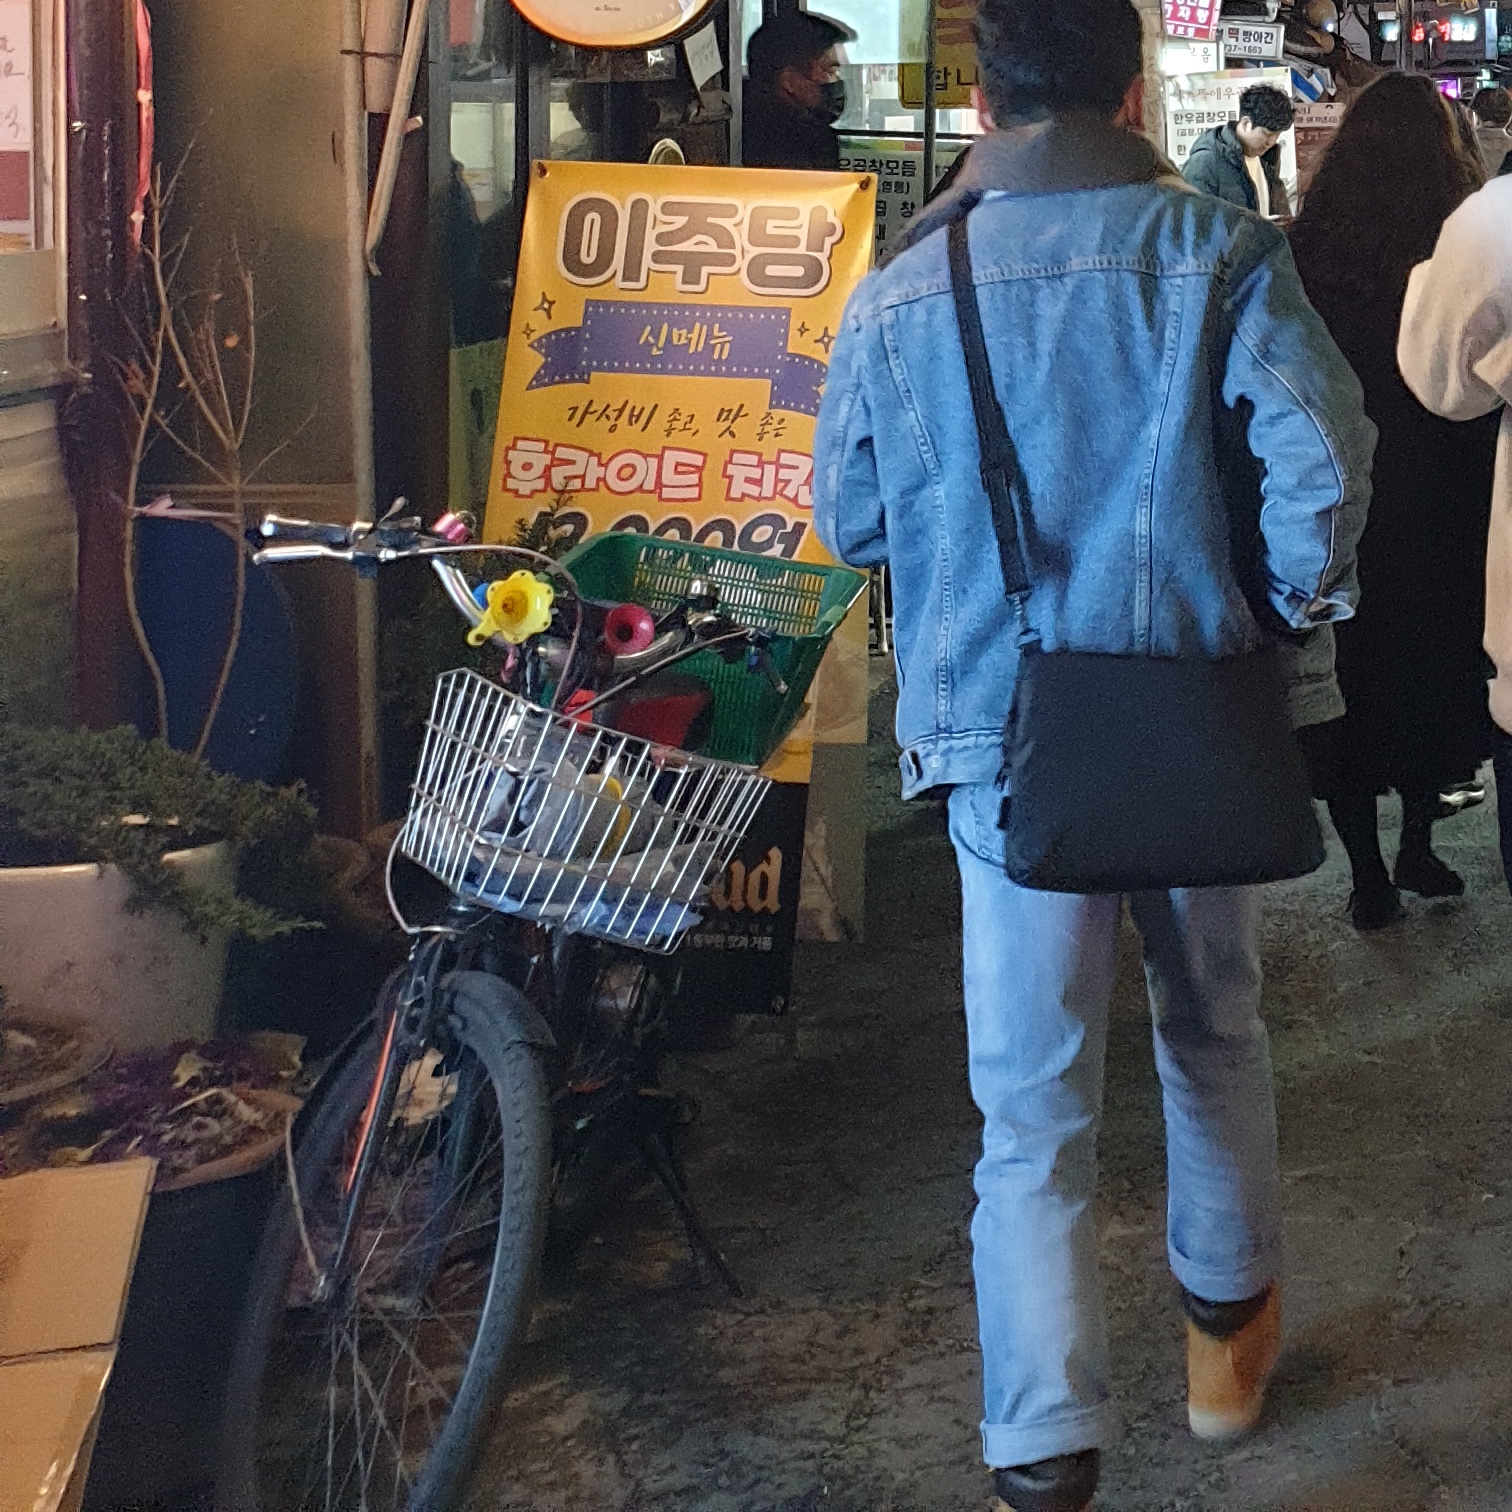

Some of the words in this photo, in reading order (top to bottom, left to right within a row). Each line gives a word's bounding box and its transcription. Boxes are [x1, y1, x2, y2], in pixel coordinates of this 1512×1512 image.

[1242, 30, 1275, 45] 방아간
[557, 191, 845, 298] 이주당
[639, 322, 733, 360] 신메뉴
[567, 399, 659, 434] 가성비
[665, 409, 700, 439] 좋고,
[716, 404, 749, 439] 맛
[757, 411, 788, 442] 좋은
[502, 436, 708, 503] 후라이드
